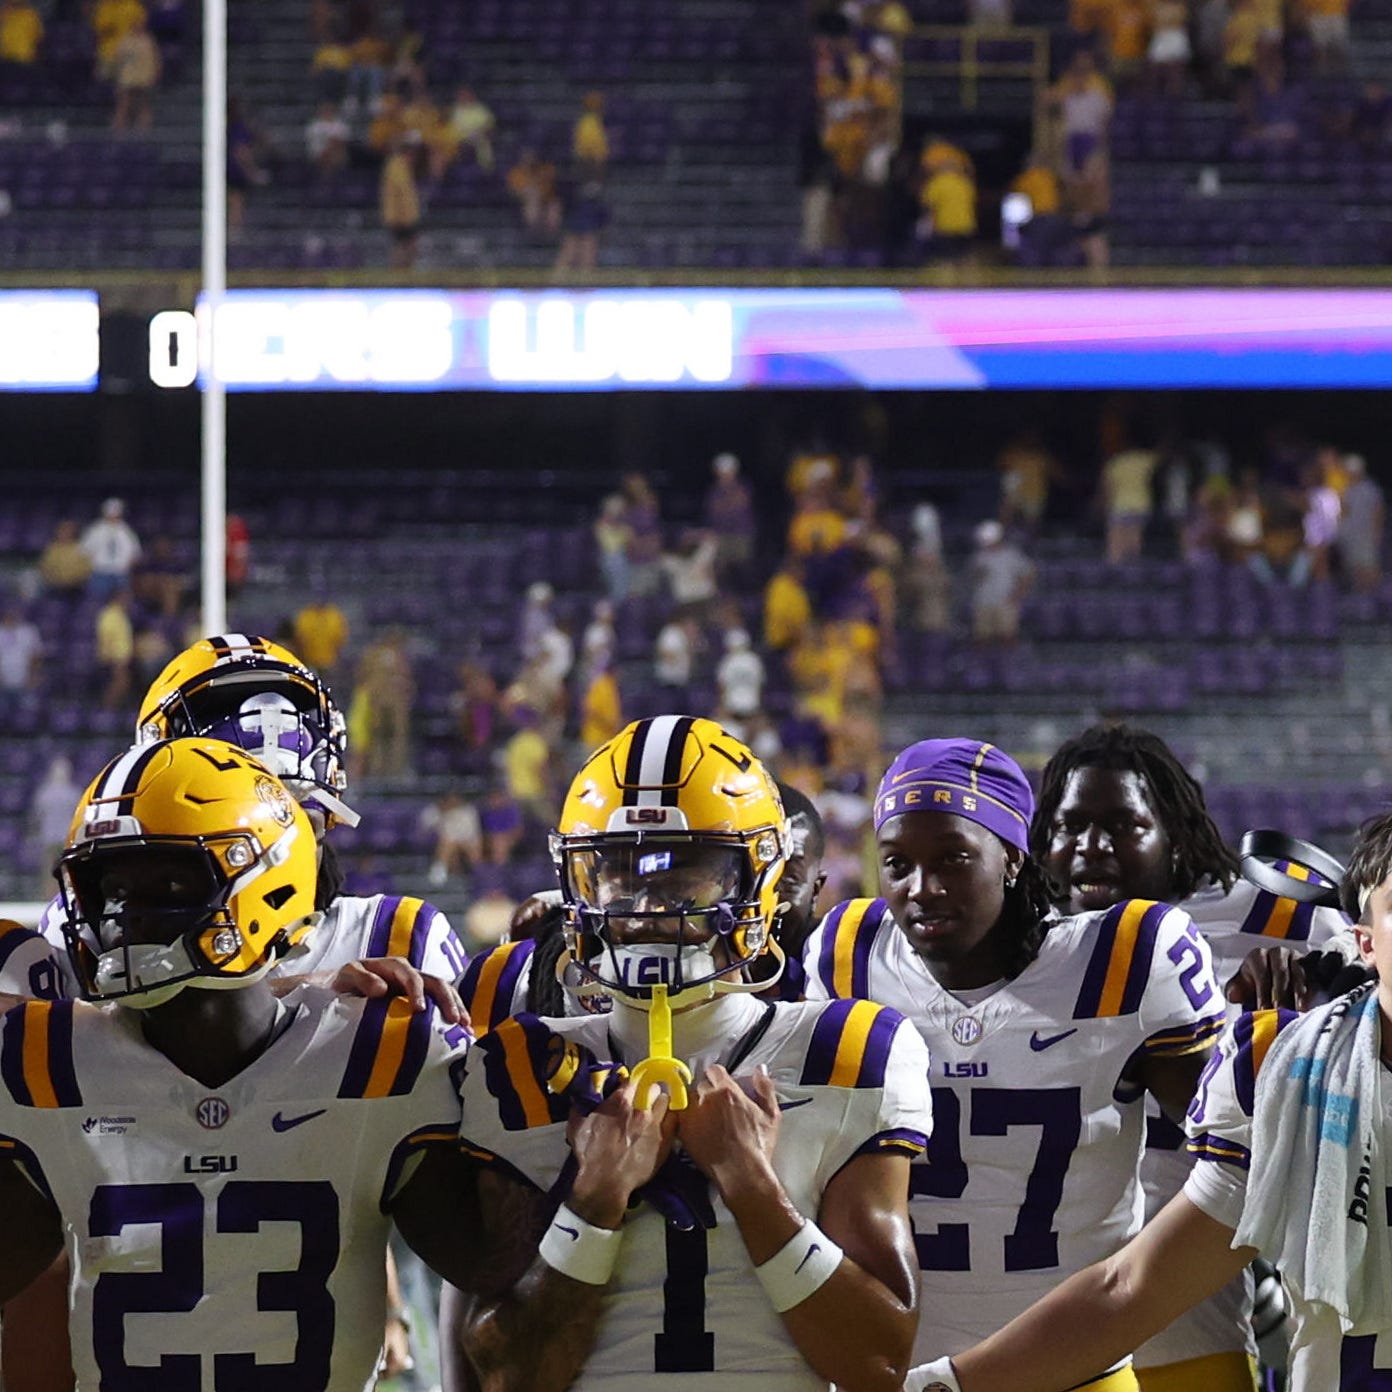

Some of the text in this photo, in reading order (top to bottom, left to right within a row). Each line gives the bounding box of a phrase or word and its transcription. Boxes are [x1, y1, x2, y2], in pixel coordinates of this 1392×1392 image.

[625, 808, 667, 825] LSU
[944, 1061, 989, 1078] LSU
[199, 1099, 228, 1128] SEC
[184, 1155, 238, 1174] LSU
[909, 1086, 1082, 1272] 27
